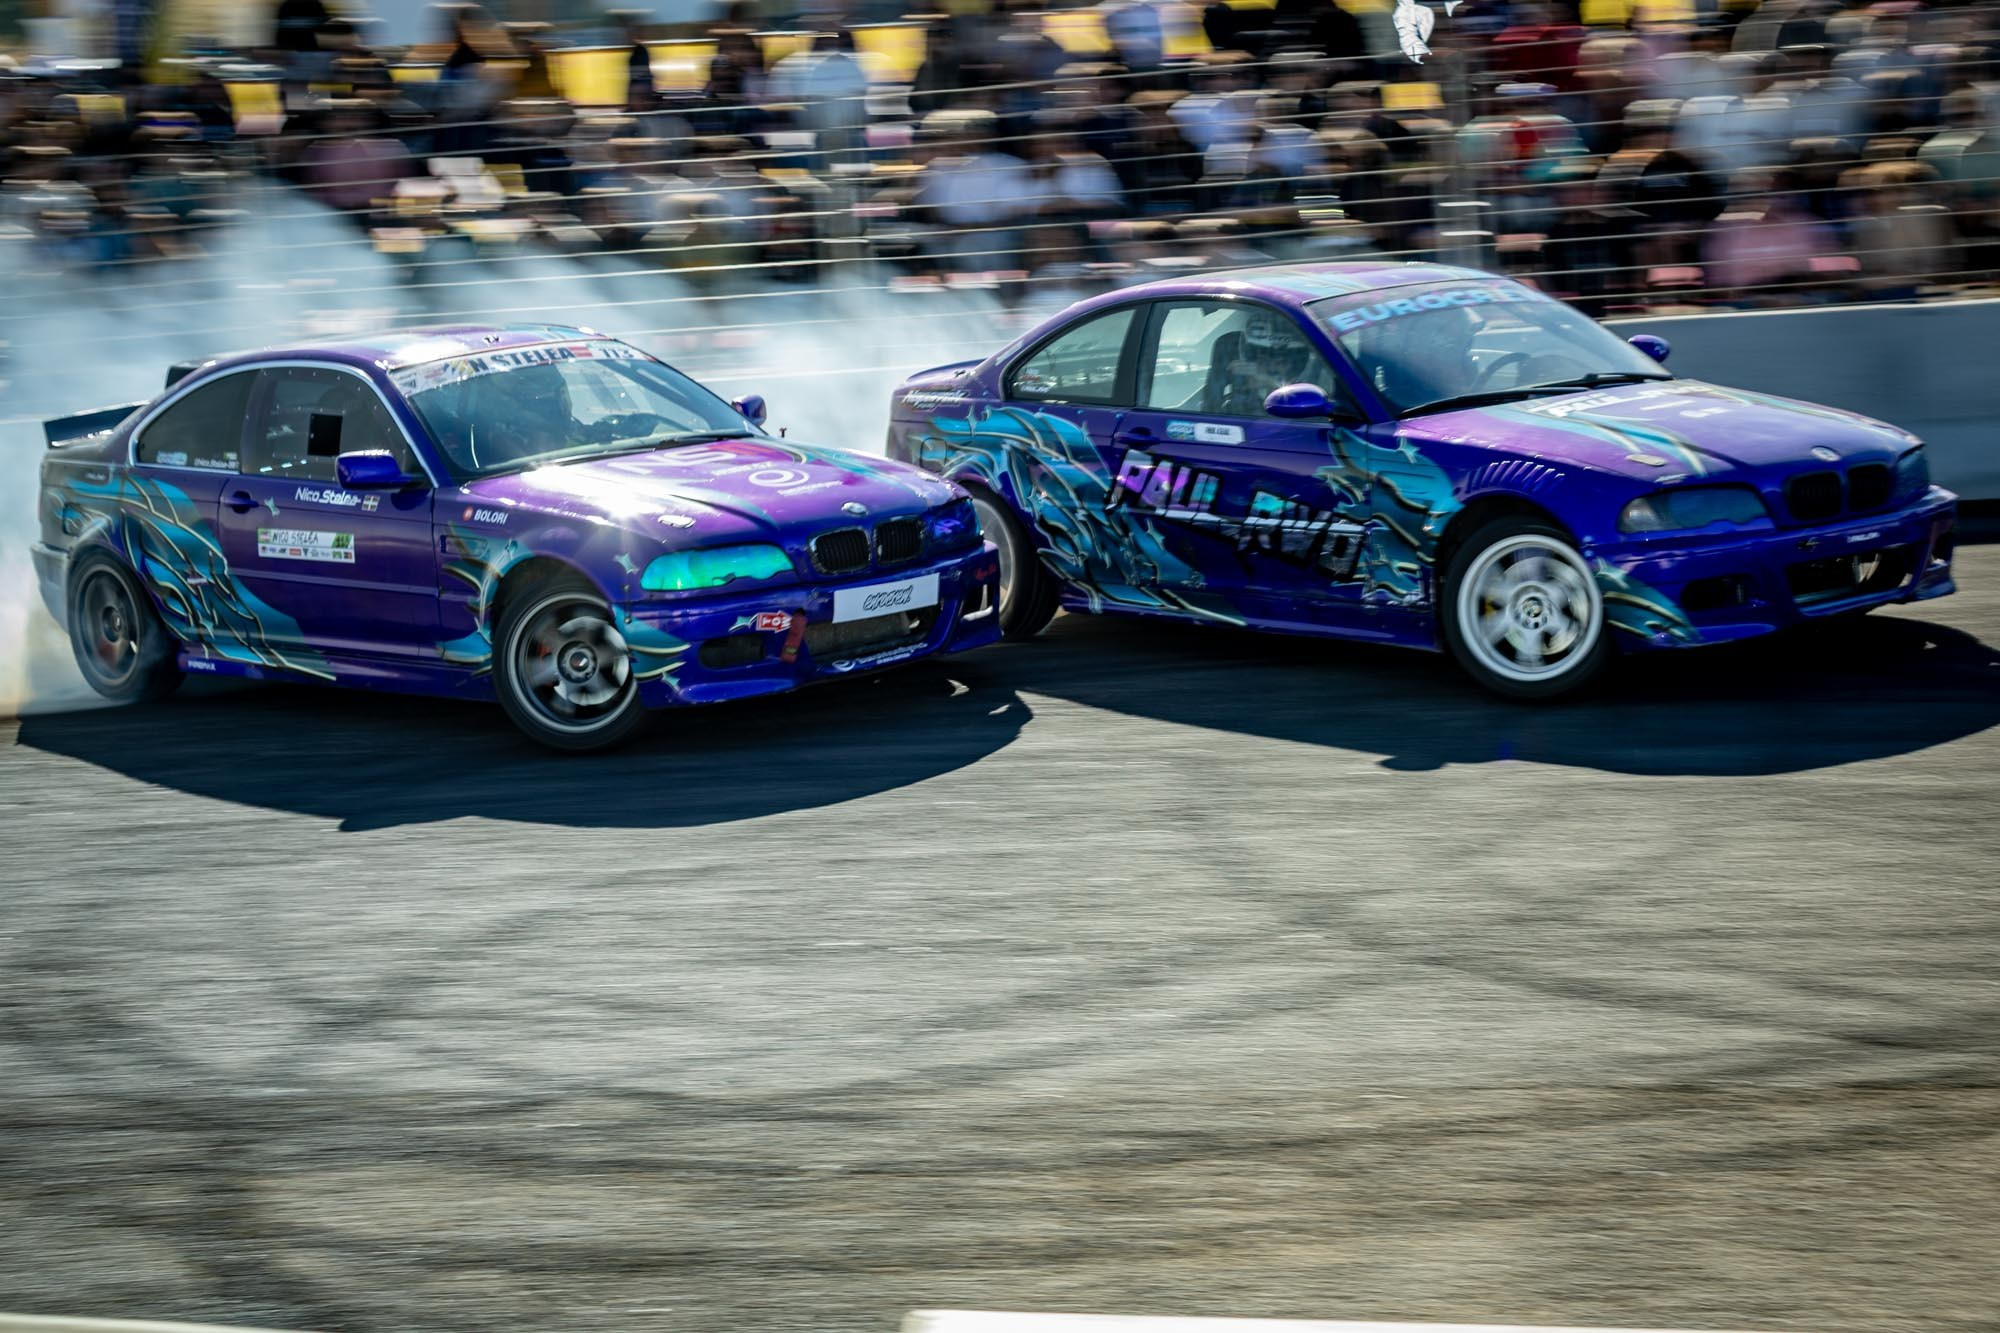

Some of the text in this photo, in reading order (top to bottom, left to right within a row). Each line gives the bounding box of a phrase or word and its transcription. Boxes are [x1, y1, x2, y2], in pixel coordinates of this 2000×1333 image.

[492, 347, 576, 367] STELEA
[1104, 449, 1220, 511] PAUL
[295, 487, 319, 502] Nico
[474, 509, 508, 525] BOLORI
